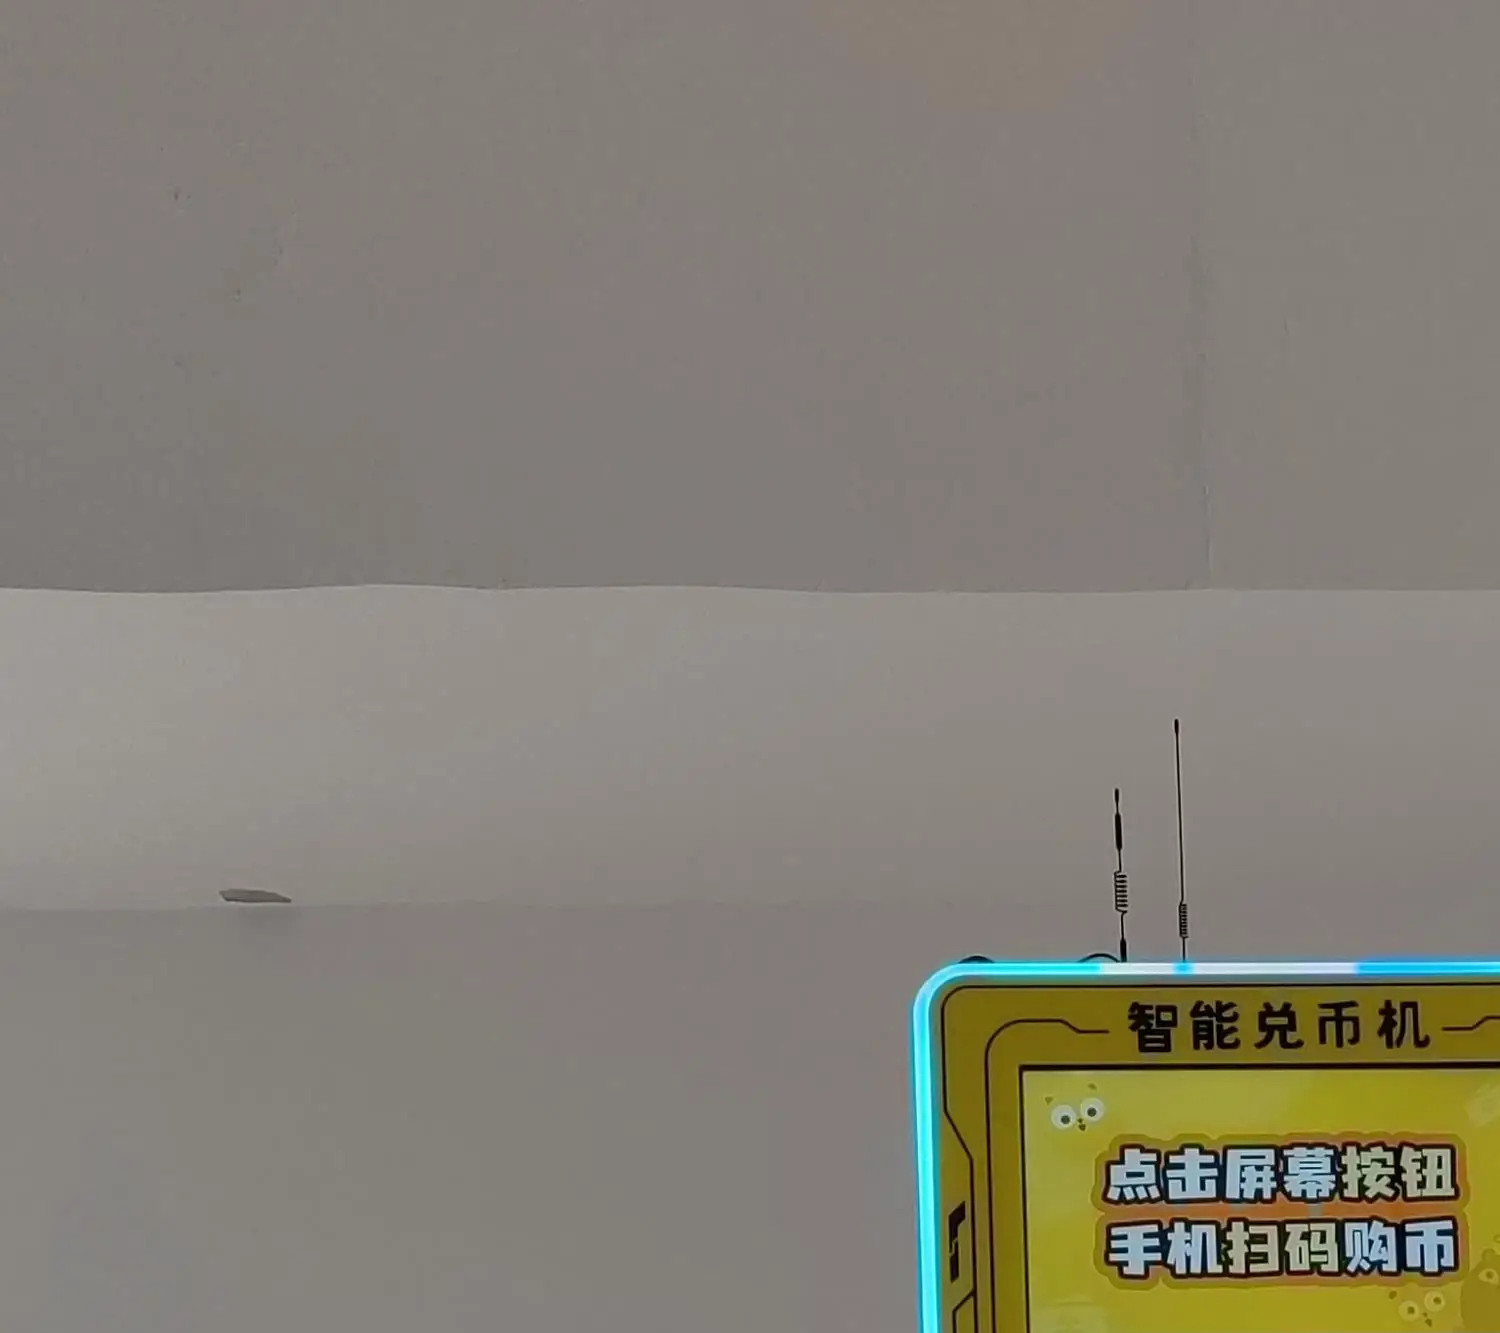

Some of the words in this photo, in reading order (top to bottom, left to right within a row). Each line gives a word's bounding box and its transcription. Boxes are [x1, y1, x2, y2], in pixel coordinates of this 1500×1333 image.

[1127, 1000, 1431, 1053] 智能兑币机
[1104, 1143, 1459, 1204] 点击屏幕按钮
[1104, 1219, 1459, 1279] 手机扫码购币
